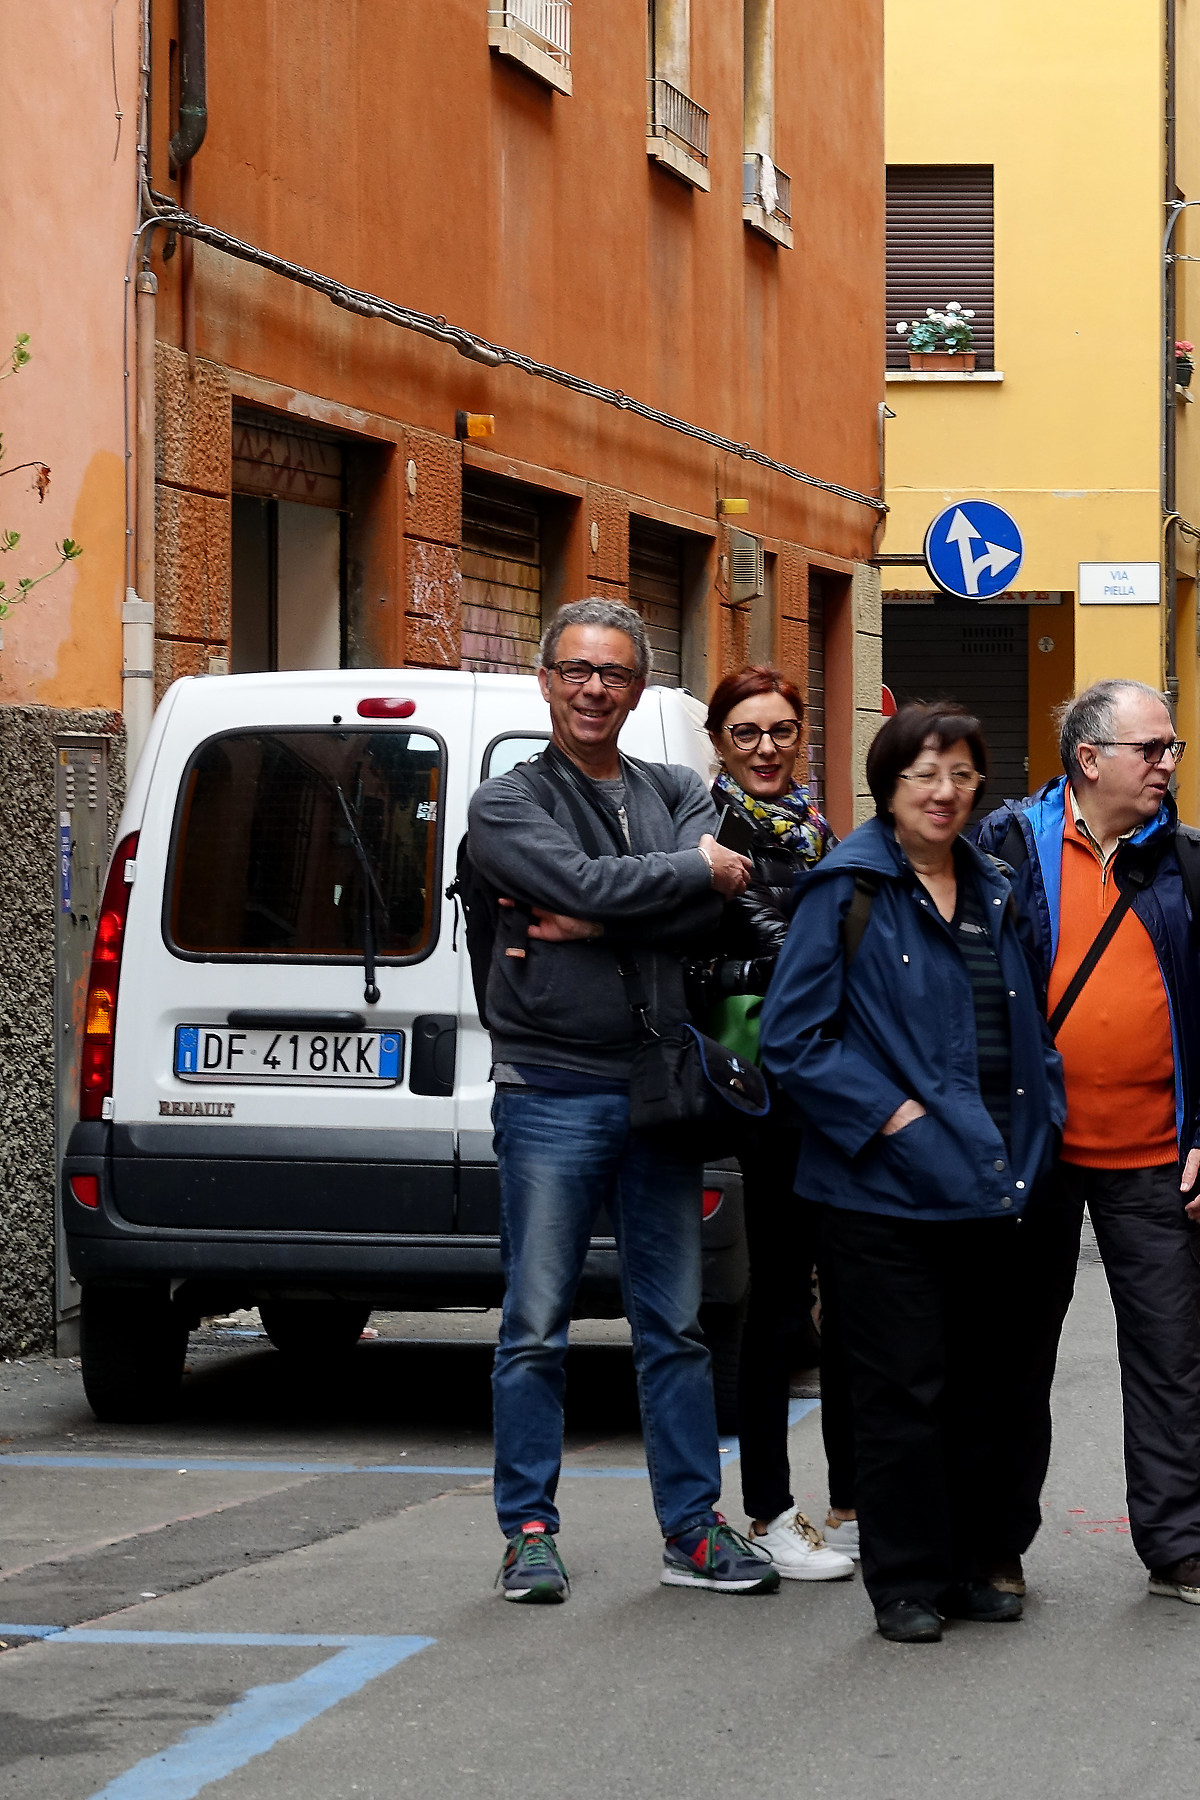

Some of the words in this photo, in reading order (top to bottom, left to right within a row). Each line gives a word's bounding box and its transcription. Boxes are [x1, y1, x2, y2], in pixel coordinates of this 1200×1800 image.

[1110, 571, 1129, 581] VIA
[1104, 586, 1136, 596] PIELLA
[203, 1033, 247, 1070] DF
[262, 1034, 375, 1073] 418KK
[159, 1100, 235, 1117] RENAULT
